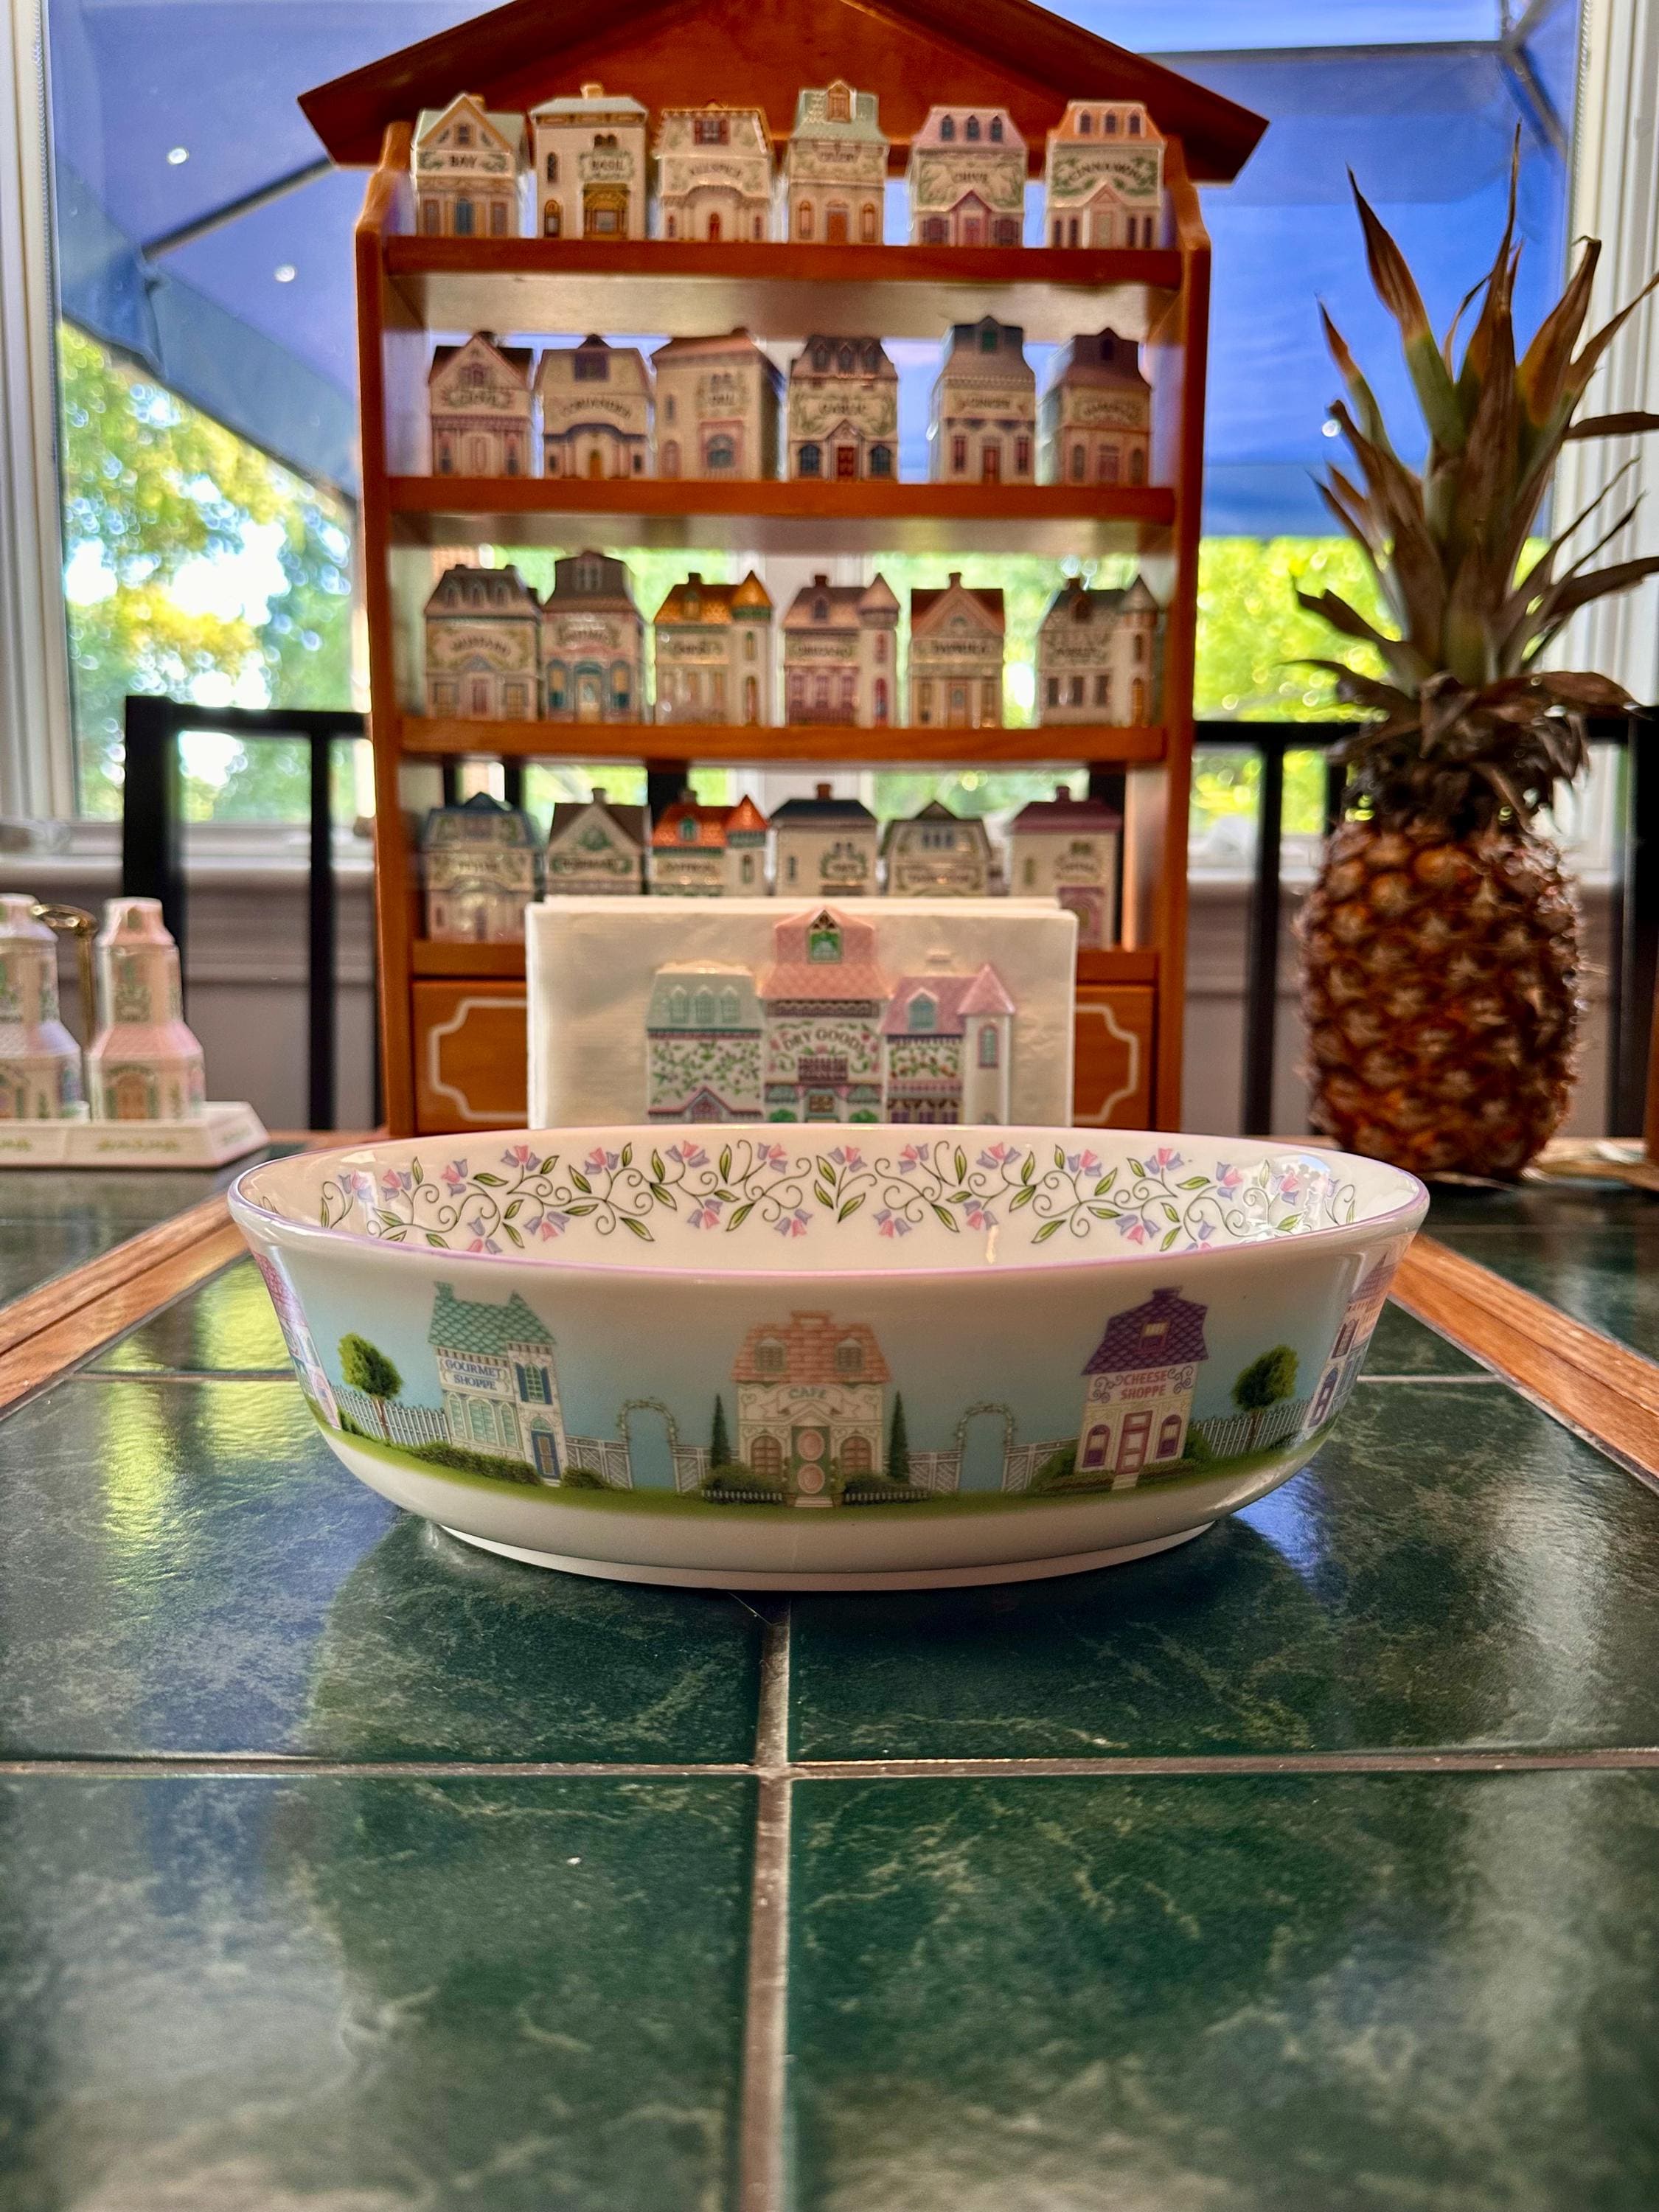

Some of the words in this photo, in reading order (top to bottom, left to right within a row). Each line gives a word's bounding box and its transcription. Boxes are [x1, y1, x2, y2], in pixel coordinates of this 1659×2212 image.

[449, 155, 477, 168] BAY
[783, 1032, 810, 1051] DRY
[815, 1028, 865, 1052] GOODS
[445, 1359, 501, 1378] GOURMET
[453, 1373, 497, 1391] SHOPPE
[1124, 1371, 1166, 1385] CHEESE
[1121, 1385, 1165, 1400] SHOPPE
